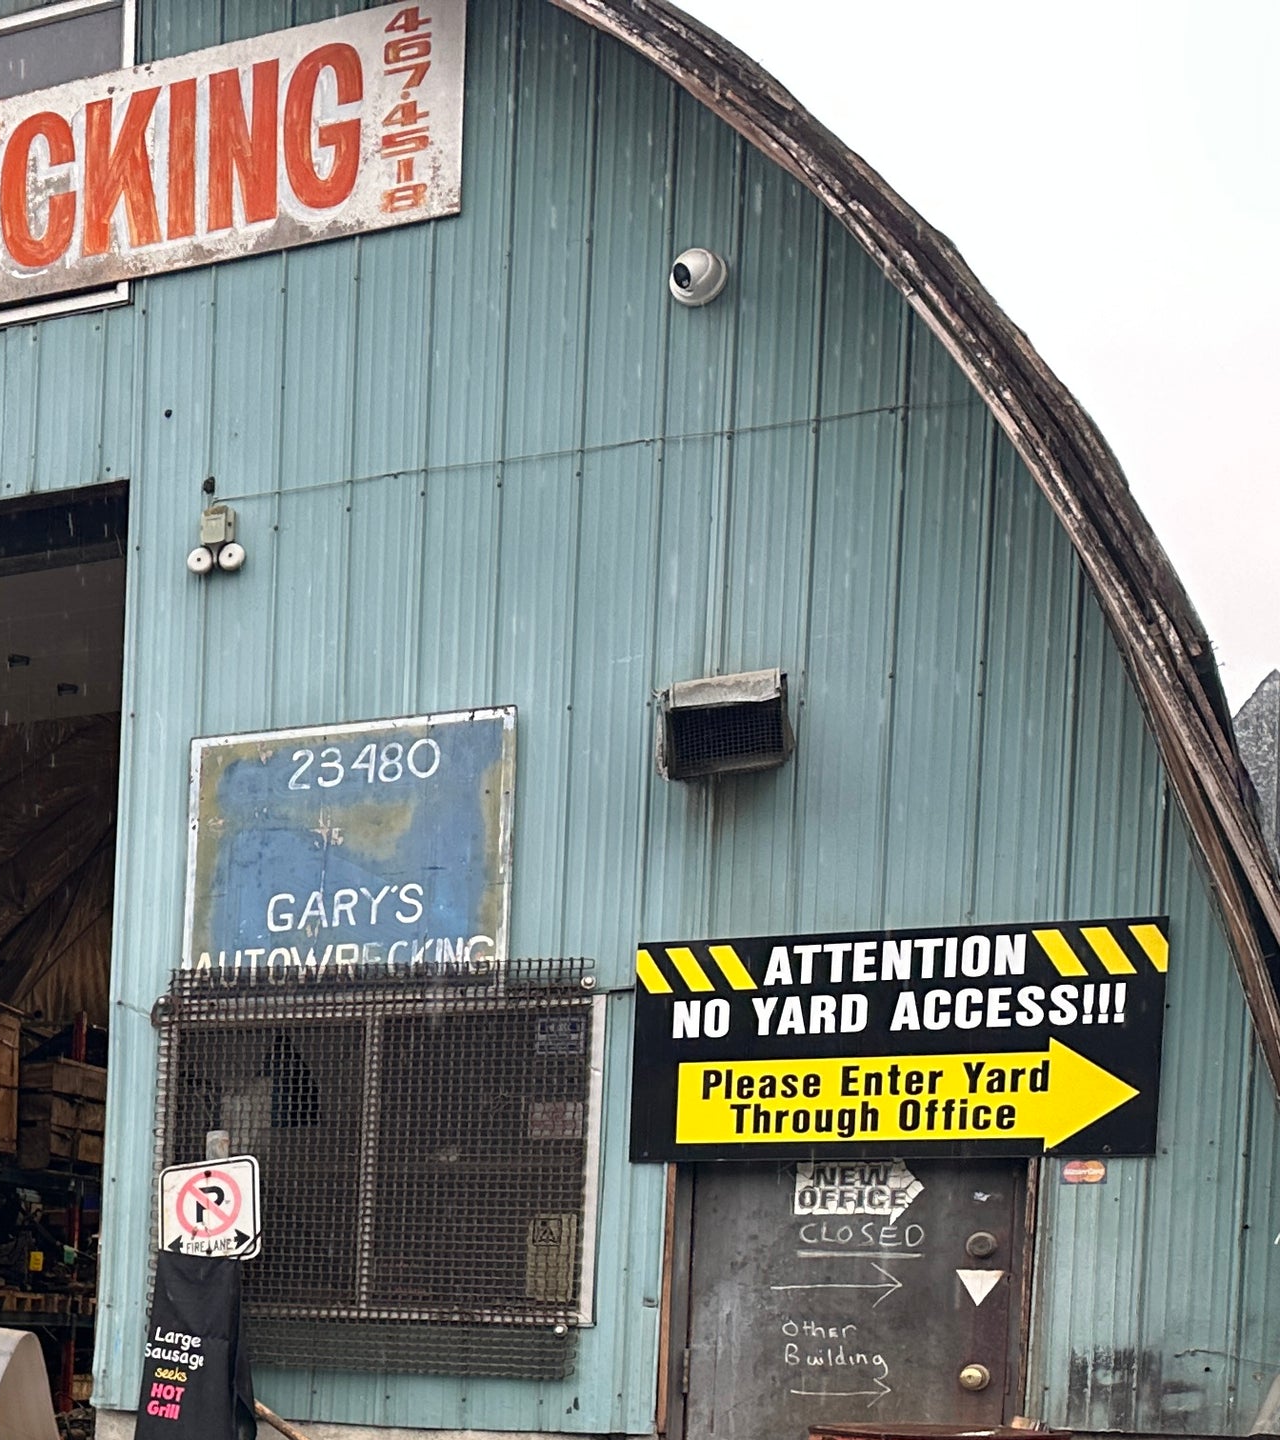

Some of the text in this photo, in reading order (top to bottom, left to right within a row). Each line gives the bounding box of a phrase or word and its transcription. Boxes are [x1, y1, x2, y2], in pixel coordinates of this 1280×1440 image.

[289, 738, 441, 790] 23480
[267, 883, 424, 932] GARY'S
[763, 934, 1026, 986] ATTENTION
[672, 982, 1127, 1039] NO YARD ACCESS!!!
[702, 1060, 1050, 1100] Please Enter Yard
[731, 1099, 1016, 1138] Through Office
[814, 1165, 889, 1186] NEW
[798, 1186, 907, 1207] OFFICE
[187, 1241, 205, 1254] FIRE
[800, 1222, 924, 1247] CLOSED
[155, 1326, 202, 1351] Large
[144, 1342, 204, 1370] Sausage
[785, 1343, 888, 1380] Building
[154, 1367, 188, 1382] seeks
[151, 1382, 185, 1402] HOT
[147, 1400, 180, 1420] Grill
